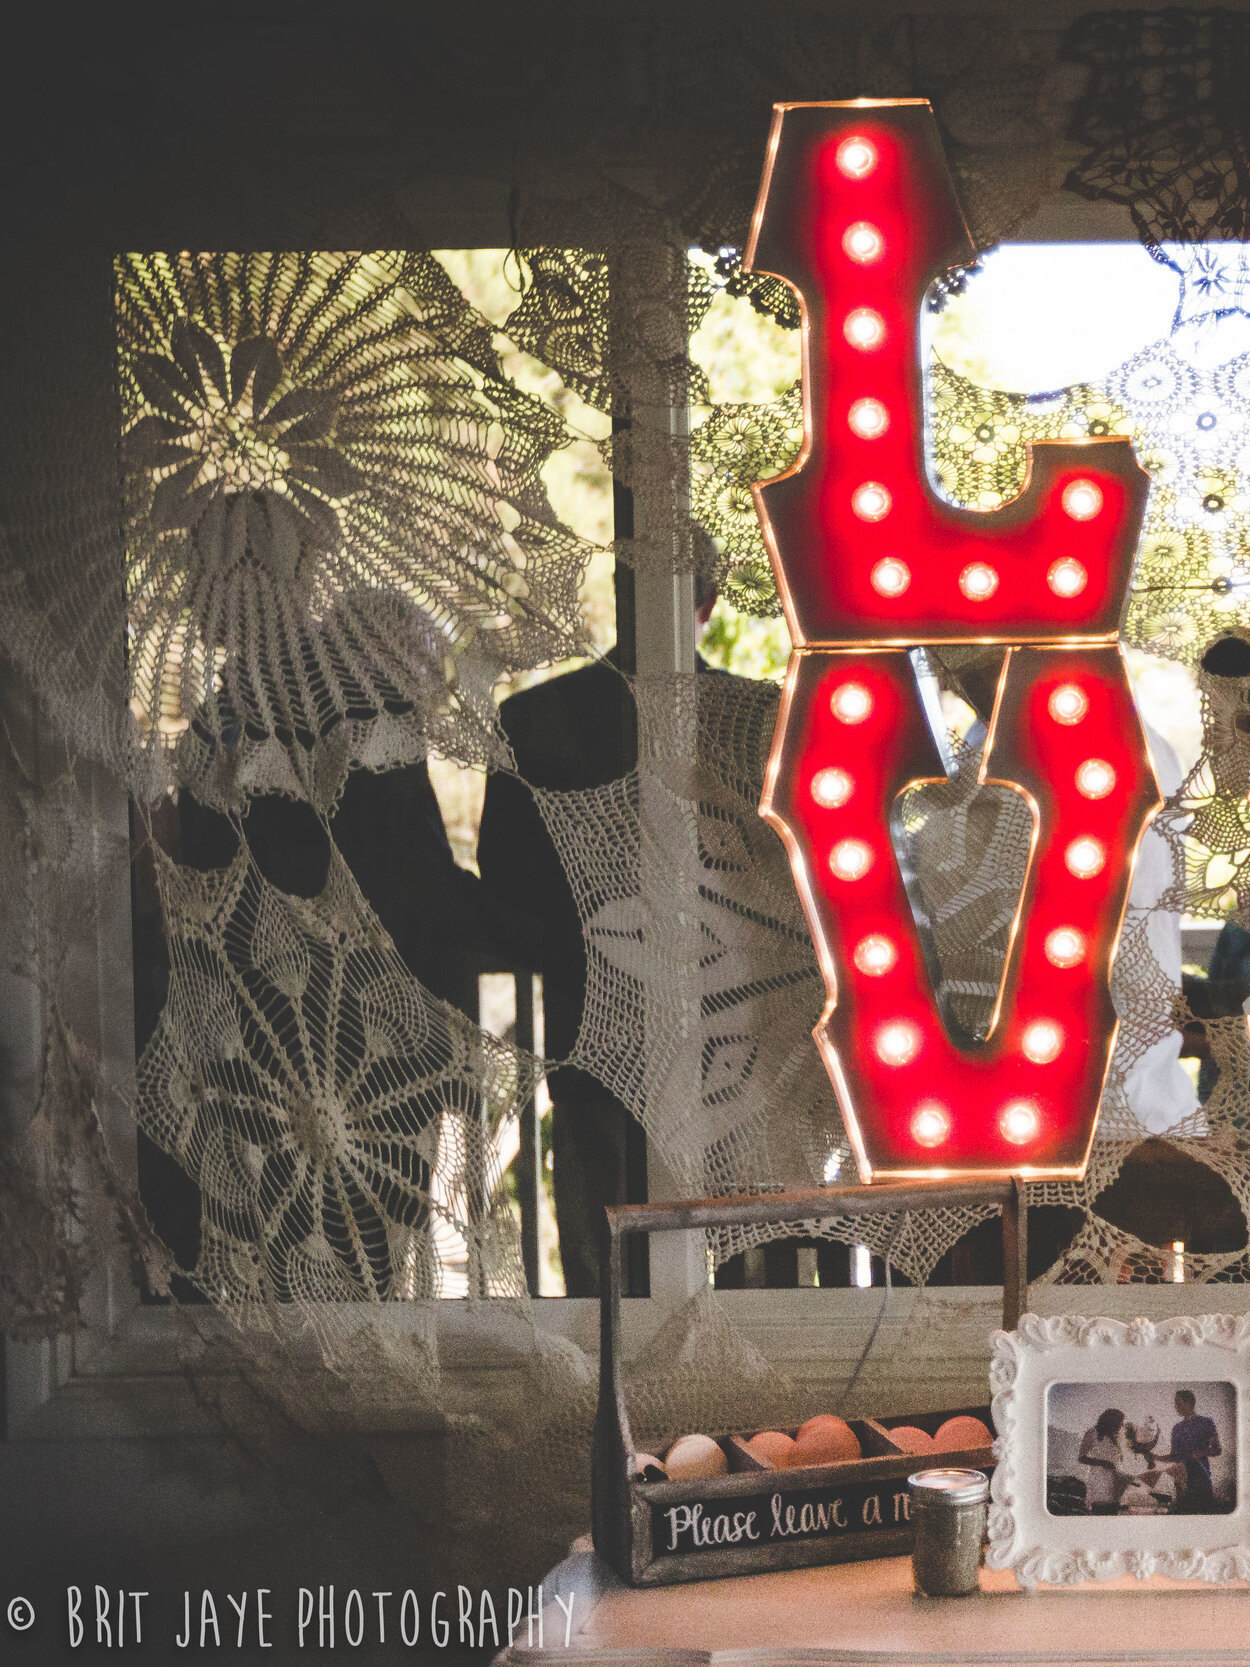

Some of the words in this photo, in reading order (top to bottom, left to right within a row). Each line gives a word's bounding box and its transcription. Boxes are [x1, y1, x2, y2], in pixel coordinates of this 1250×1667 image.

[663, 1503, 761, 1550] Please
[769, 1493, 848, 1537] leave
[862, 1494, 883, 1525] a
